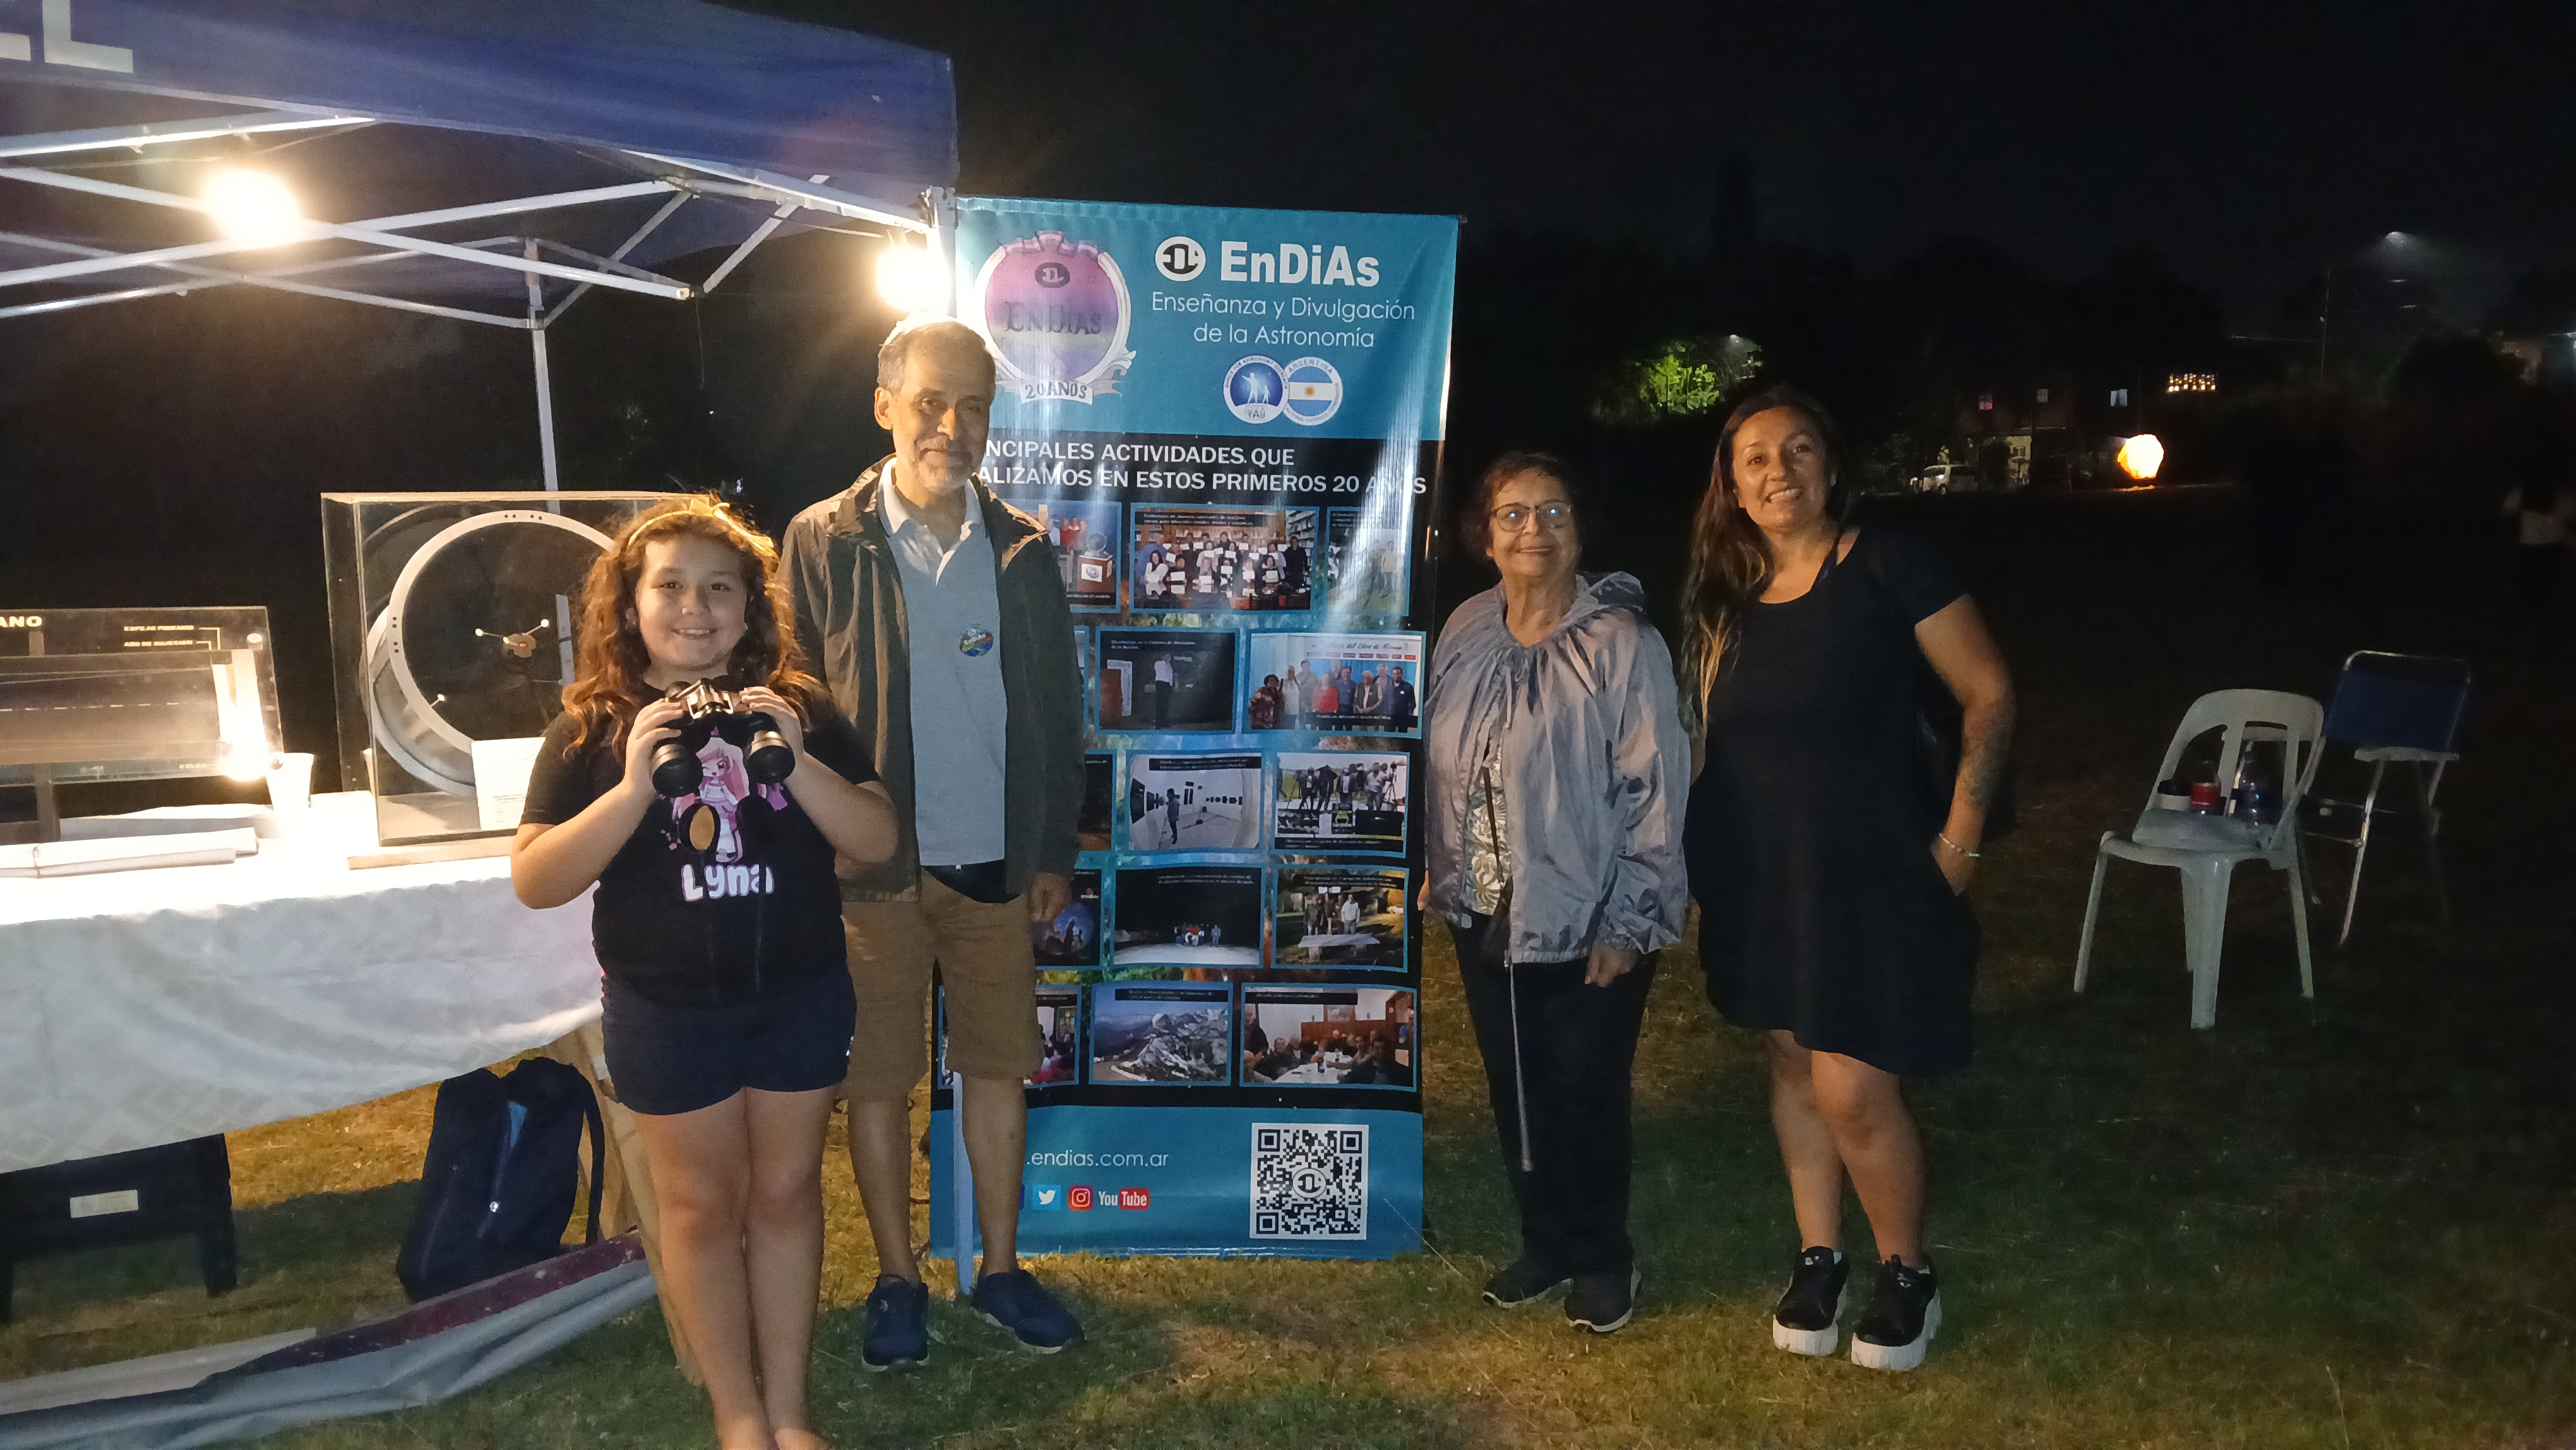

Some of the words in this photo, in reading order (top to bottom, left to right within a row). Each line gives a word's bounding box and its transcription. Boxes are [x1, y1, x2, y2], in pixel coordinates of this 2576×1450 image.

[0, 0, 133, 73] L
[1221, 241, 1380, 287] EnDiAs
[1152, 291, 1266, 315] Enseñanza
[1273, 300, 1285, 320] y
[1292, 297, 1415, 323] Divulgación
[1194, 323, 1222, 342] de
[1229, 323, 1248, 344] la
[1255, 325, 1374, 347] Astronomía
[1288, 359, 1333, 375] ARGENTINA
[1251, 448, 1295, 468] QUE
[1100, 470, 1128, 487] EN
[1136, 471, 1205, 489] ESTOS
[1212, 473, 1326, 492] PRIMEROS
[1332, 476, 1359, 493] 20
[681, 864, 775, 902] Lyna
